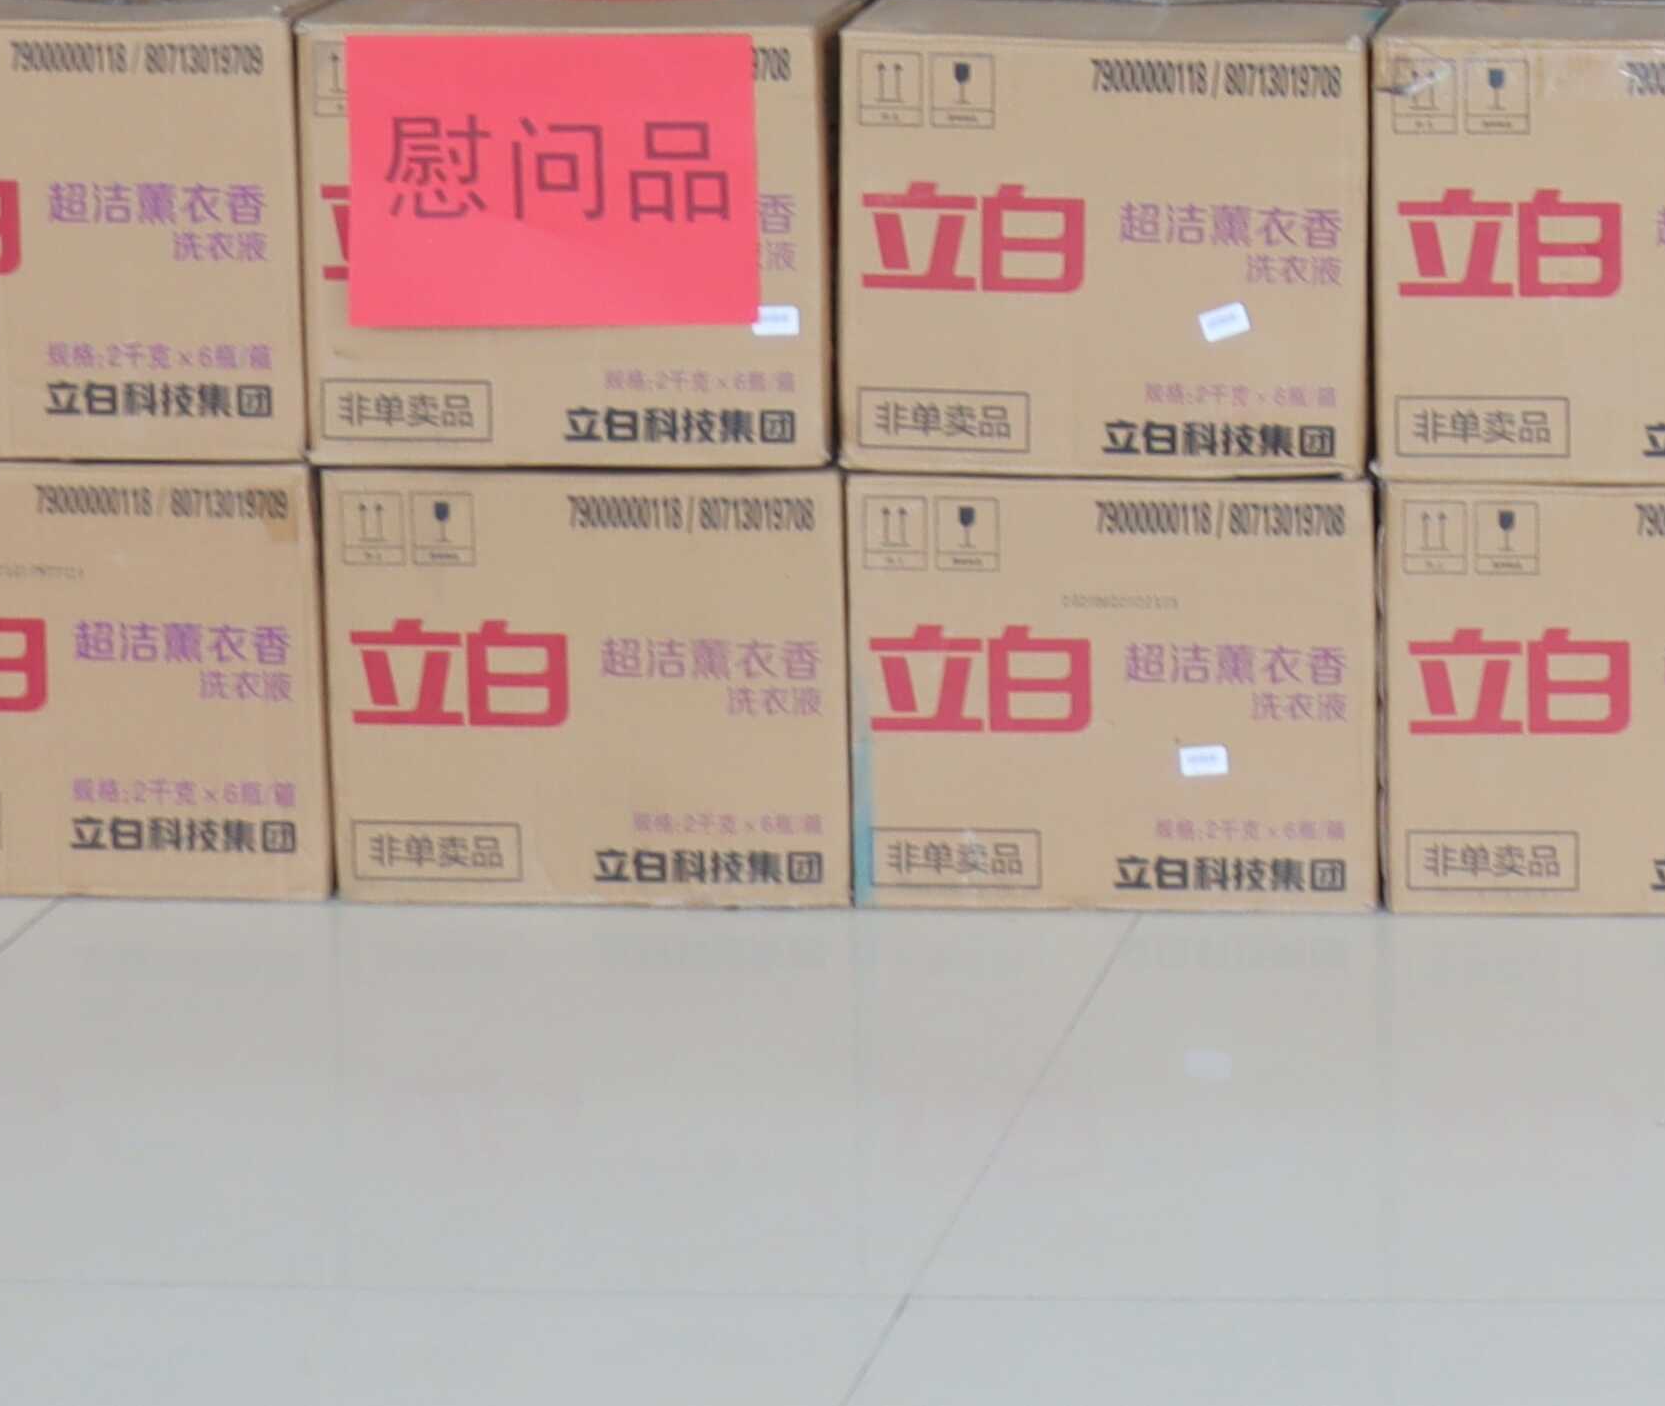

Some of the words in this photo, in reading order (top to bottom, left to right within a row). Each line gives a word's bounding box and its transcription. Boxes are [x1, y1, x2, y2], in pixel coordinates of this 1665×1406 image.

[387, 114, 730, 222] 慰问品
[49, 182, 264, 226] 超洁薰衣香
[862, 181, 1086, 294] 立白
[1120, 202, 1341, 249] 超洁薰衣香
[1397, 188, 1623, 298] 立白
[173, 231, 266, 262] 洗衣液
[1246, 252, 1341, 285] 洗衣液
[46, 381, 273, 418] 立白科技集团
[339, 391, 473, 430] 非单卖品
[875, 399, 1012, 439] 非单卖品
[565, 407, 796, 444] 立白科技集团
[1103, 420, 1335, 458] 立白科技集团
[1413, 406, 1551, 444] 非单卖品
[75, 620, 289, 666] 超洁薰衣香
[601, 638, 818, 682] 超洁薰衣香
[349, 618, 570, 728] 立白
[869, 624, 1092, 734] 立白
[1126, 643, 1345, 688] 超洁薰衣香
[1408, 627, 1632, 736] 立白
[200, 669, 291, 702] 洗衣液
[727, 686, 821, 716] 洗衣液
[1252, 692, 1346, 722] 洗衣液
[71, 816, 297, 854] 立白科技集团
[368, 833, 505, 872] 非单卖品
[594, 848, 823, 884] 立白科技集团
[887, 839, 1024, 878] 非单卖品
[1114, 855, 1346, 892] 立白科技集团
[1424, 841, 1560, 880] 非单卖品
